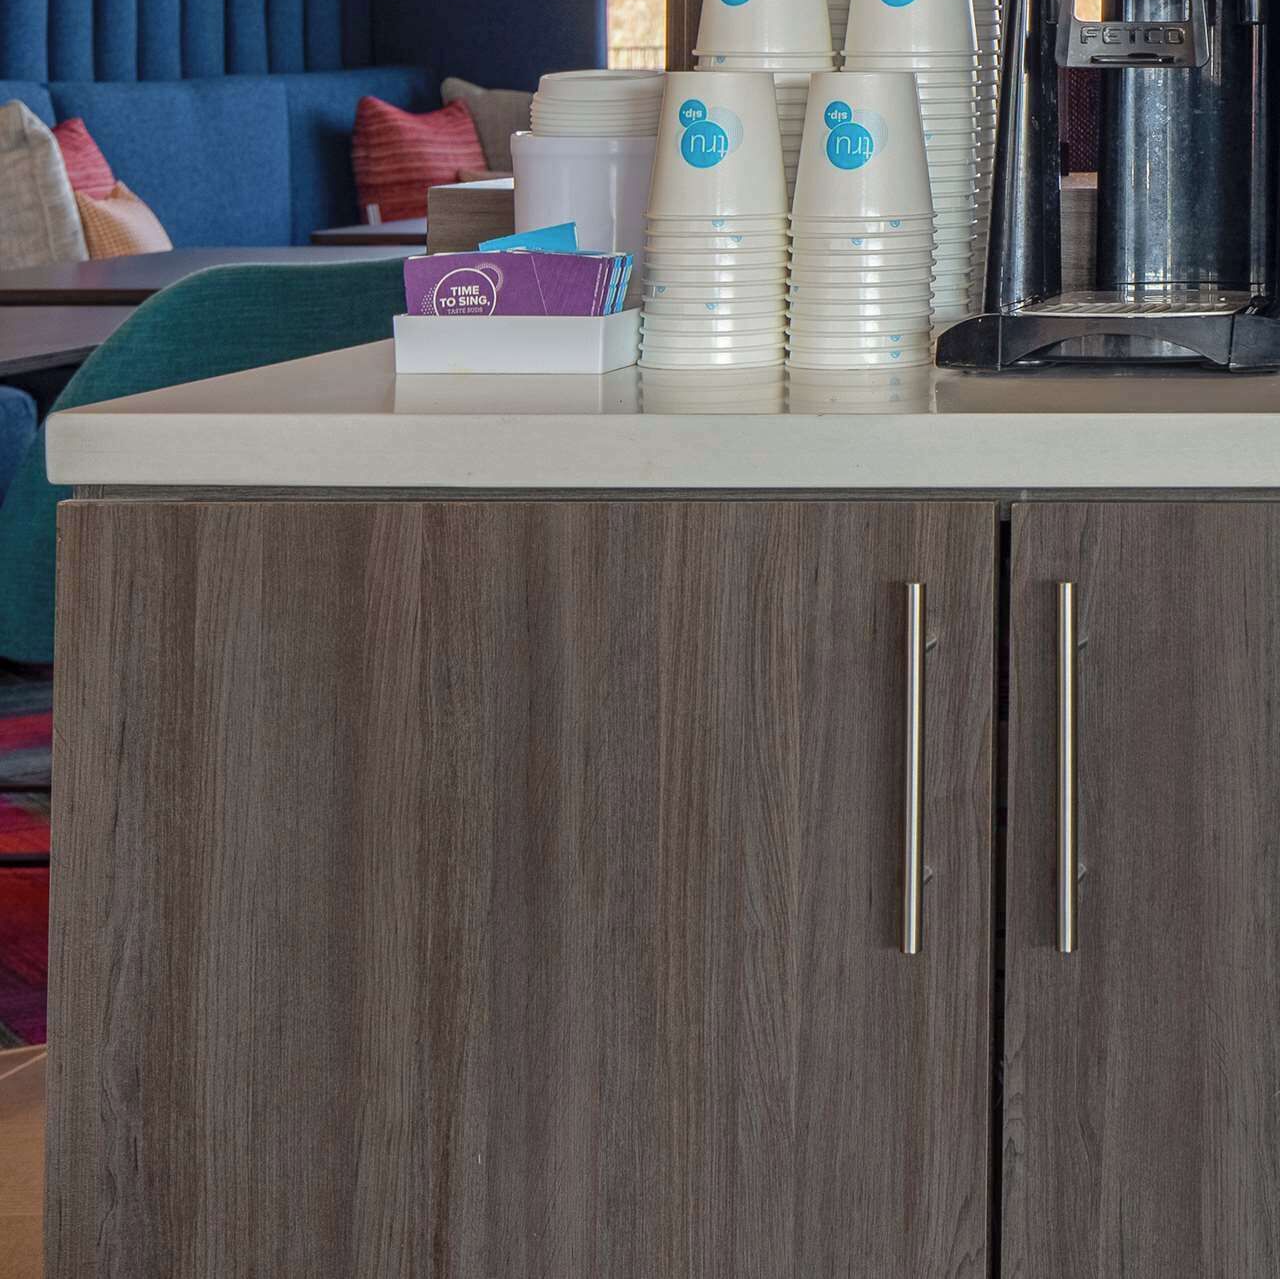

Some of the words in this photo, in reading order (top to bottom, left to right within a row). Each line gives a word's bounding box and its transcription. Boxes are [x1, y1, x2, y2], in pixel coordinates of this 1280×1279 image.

[1080, 25, 1186, 45] FETCO
[690, 134, 727, 157] tru
[836, 135, 872, 159] tru
[450, 285, 480, 297] TIME
[439, 297, 457, 308] TO
[458, 295, 491, 307] SING,
